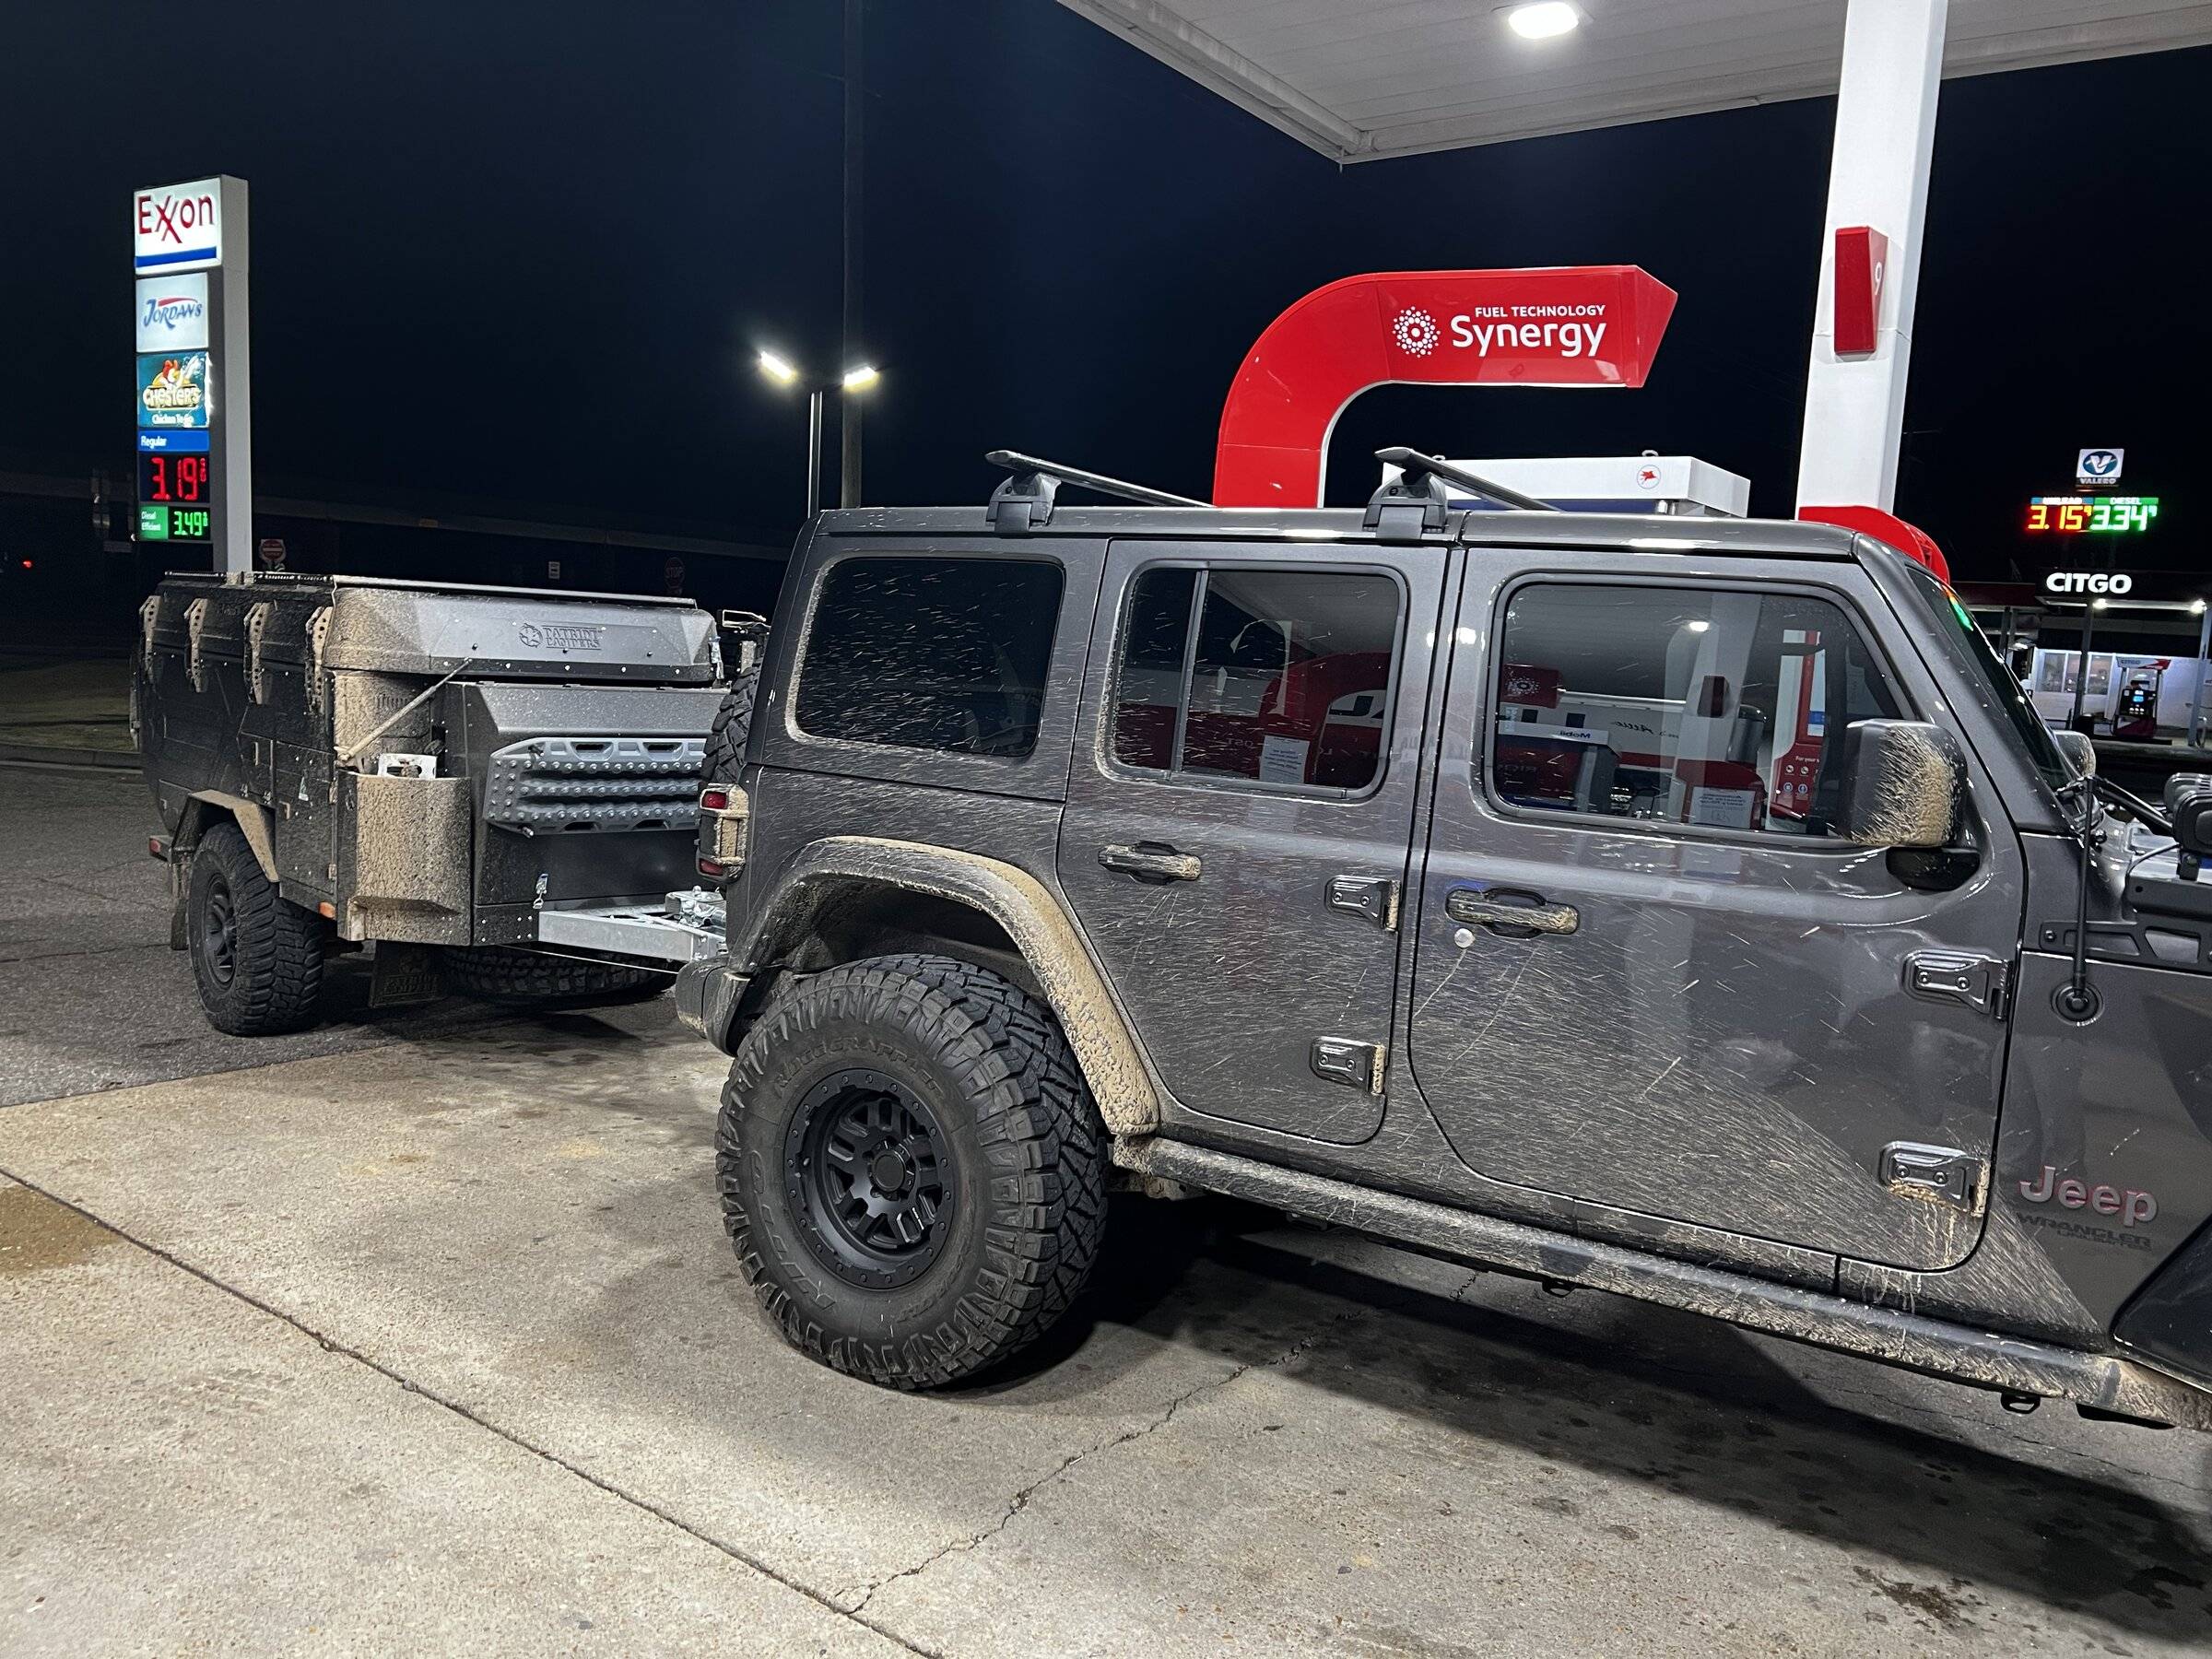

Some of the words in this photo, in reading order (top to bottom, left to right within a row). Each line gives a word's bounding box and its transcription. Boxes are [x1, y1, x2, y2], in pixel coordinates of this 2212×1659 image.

[138, 194, 214, 243] Exxon
[1875, 262, 1882, 295] 9
[1475, 307, 1508, 318] FUEL
[1511, 305, 1606, 317] TECHNOLOGY
[1450, 315, 1606, 357] Synergy
[141, 435, 167, 449] Regular
[2110, 497, 2143, 505] DIESEL
[2046, 572, 2132, 594] CITGO
[542, 628, 598, 640] PATRIOT
[2019, 1165, 2158, 1227] Jeep
